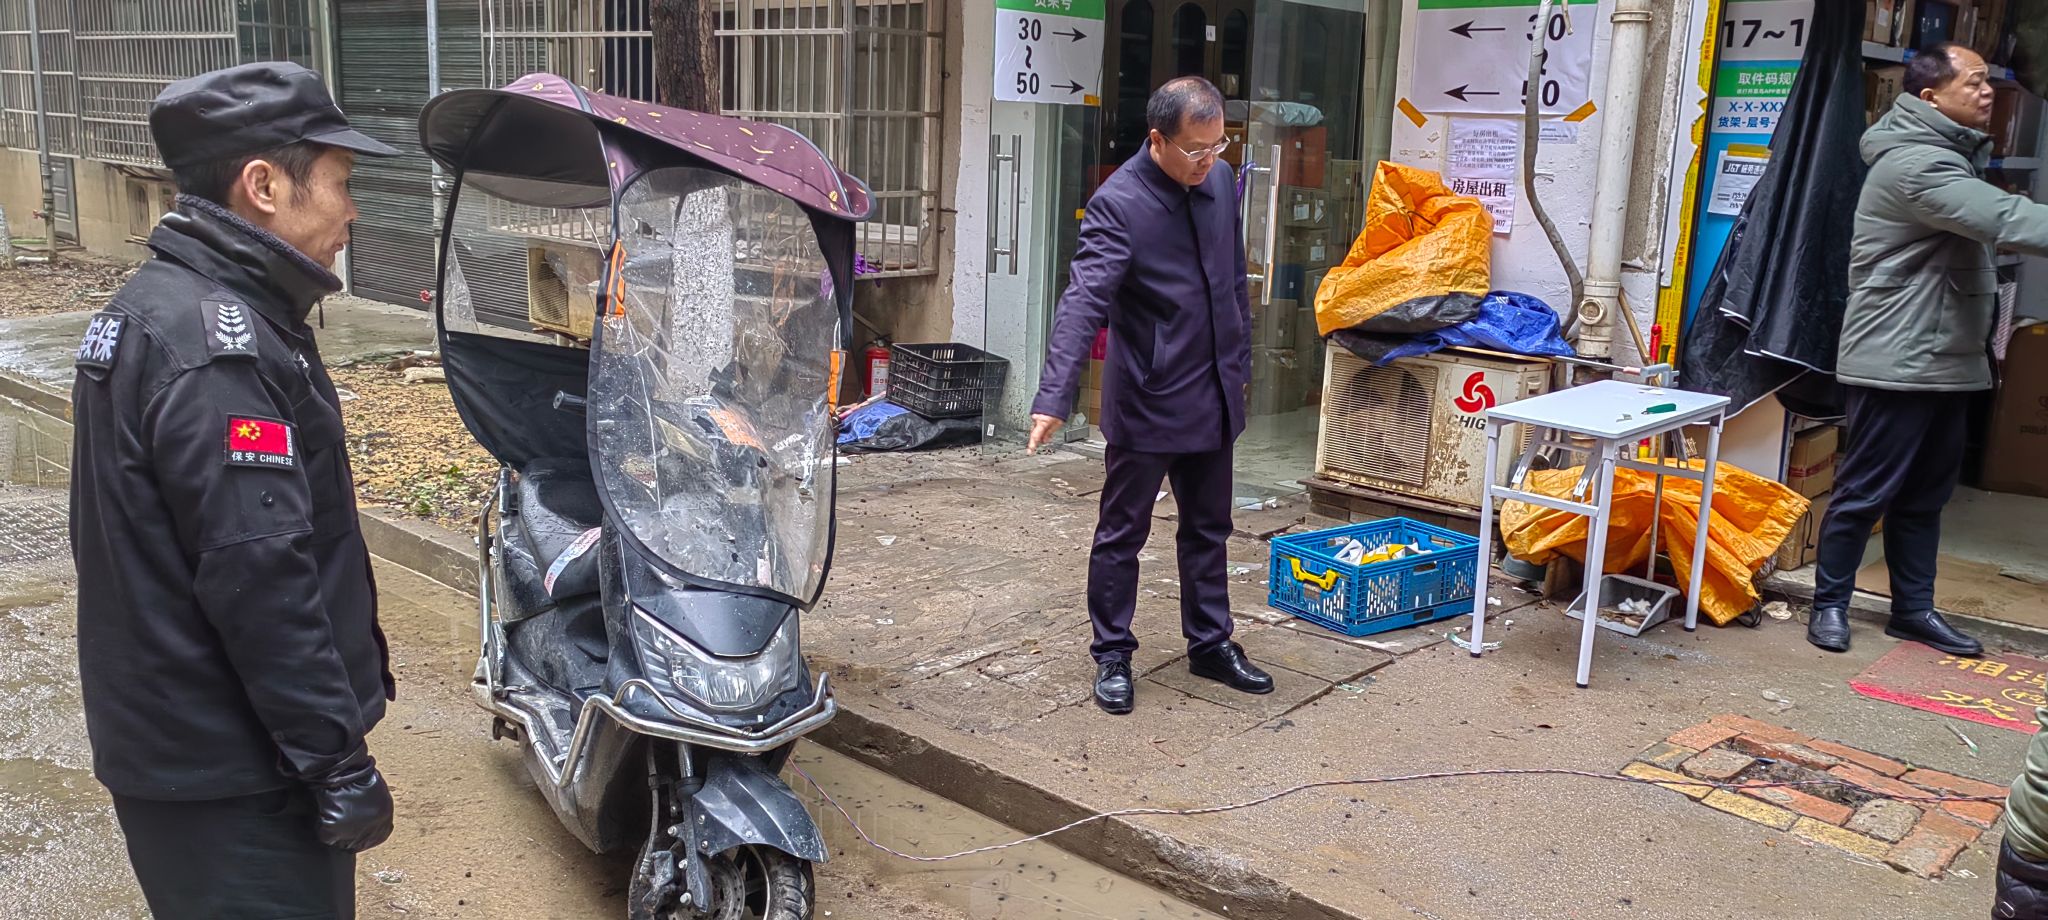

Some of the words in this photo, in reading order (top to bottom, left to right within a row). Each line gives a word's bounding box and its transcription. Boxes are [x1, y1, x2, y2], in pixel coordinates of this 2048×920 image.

[1018, 17, 1042, 42] 30
[1016, 72, 1040, 95] 50
[1738, 72, 1797, 85] 取件码规
[1718, 116, 1780, 128] 货架-层号-
[1724, 163, 1741, 173] J&T
[1452, 178, 1507, 198] 房屋出租
[231, 451, 256, 462] 保安
[259, 454, 294, 466] CHINESE
